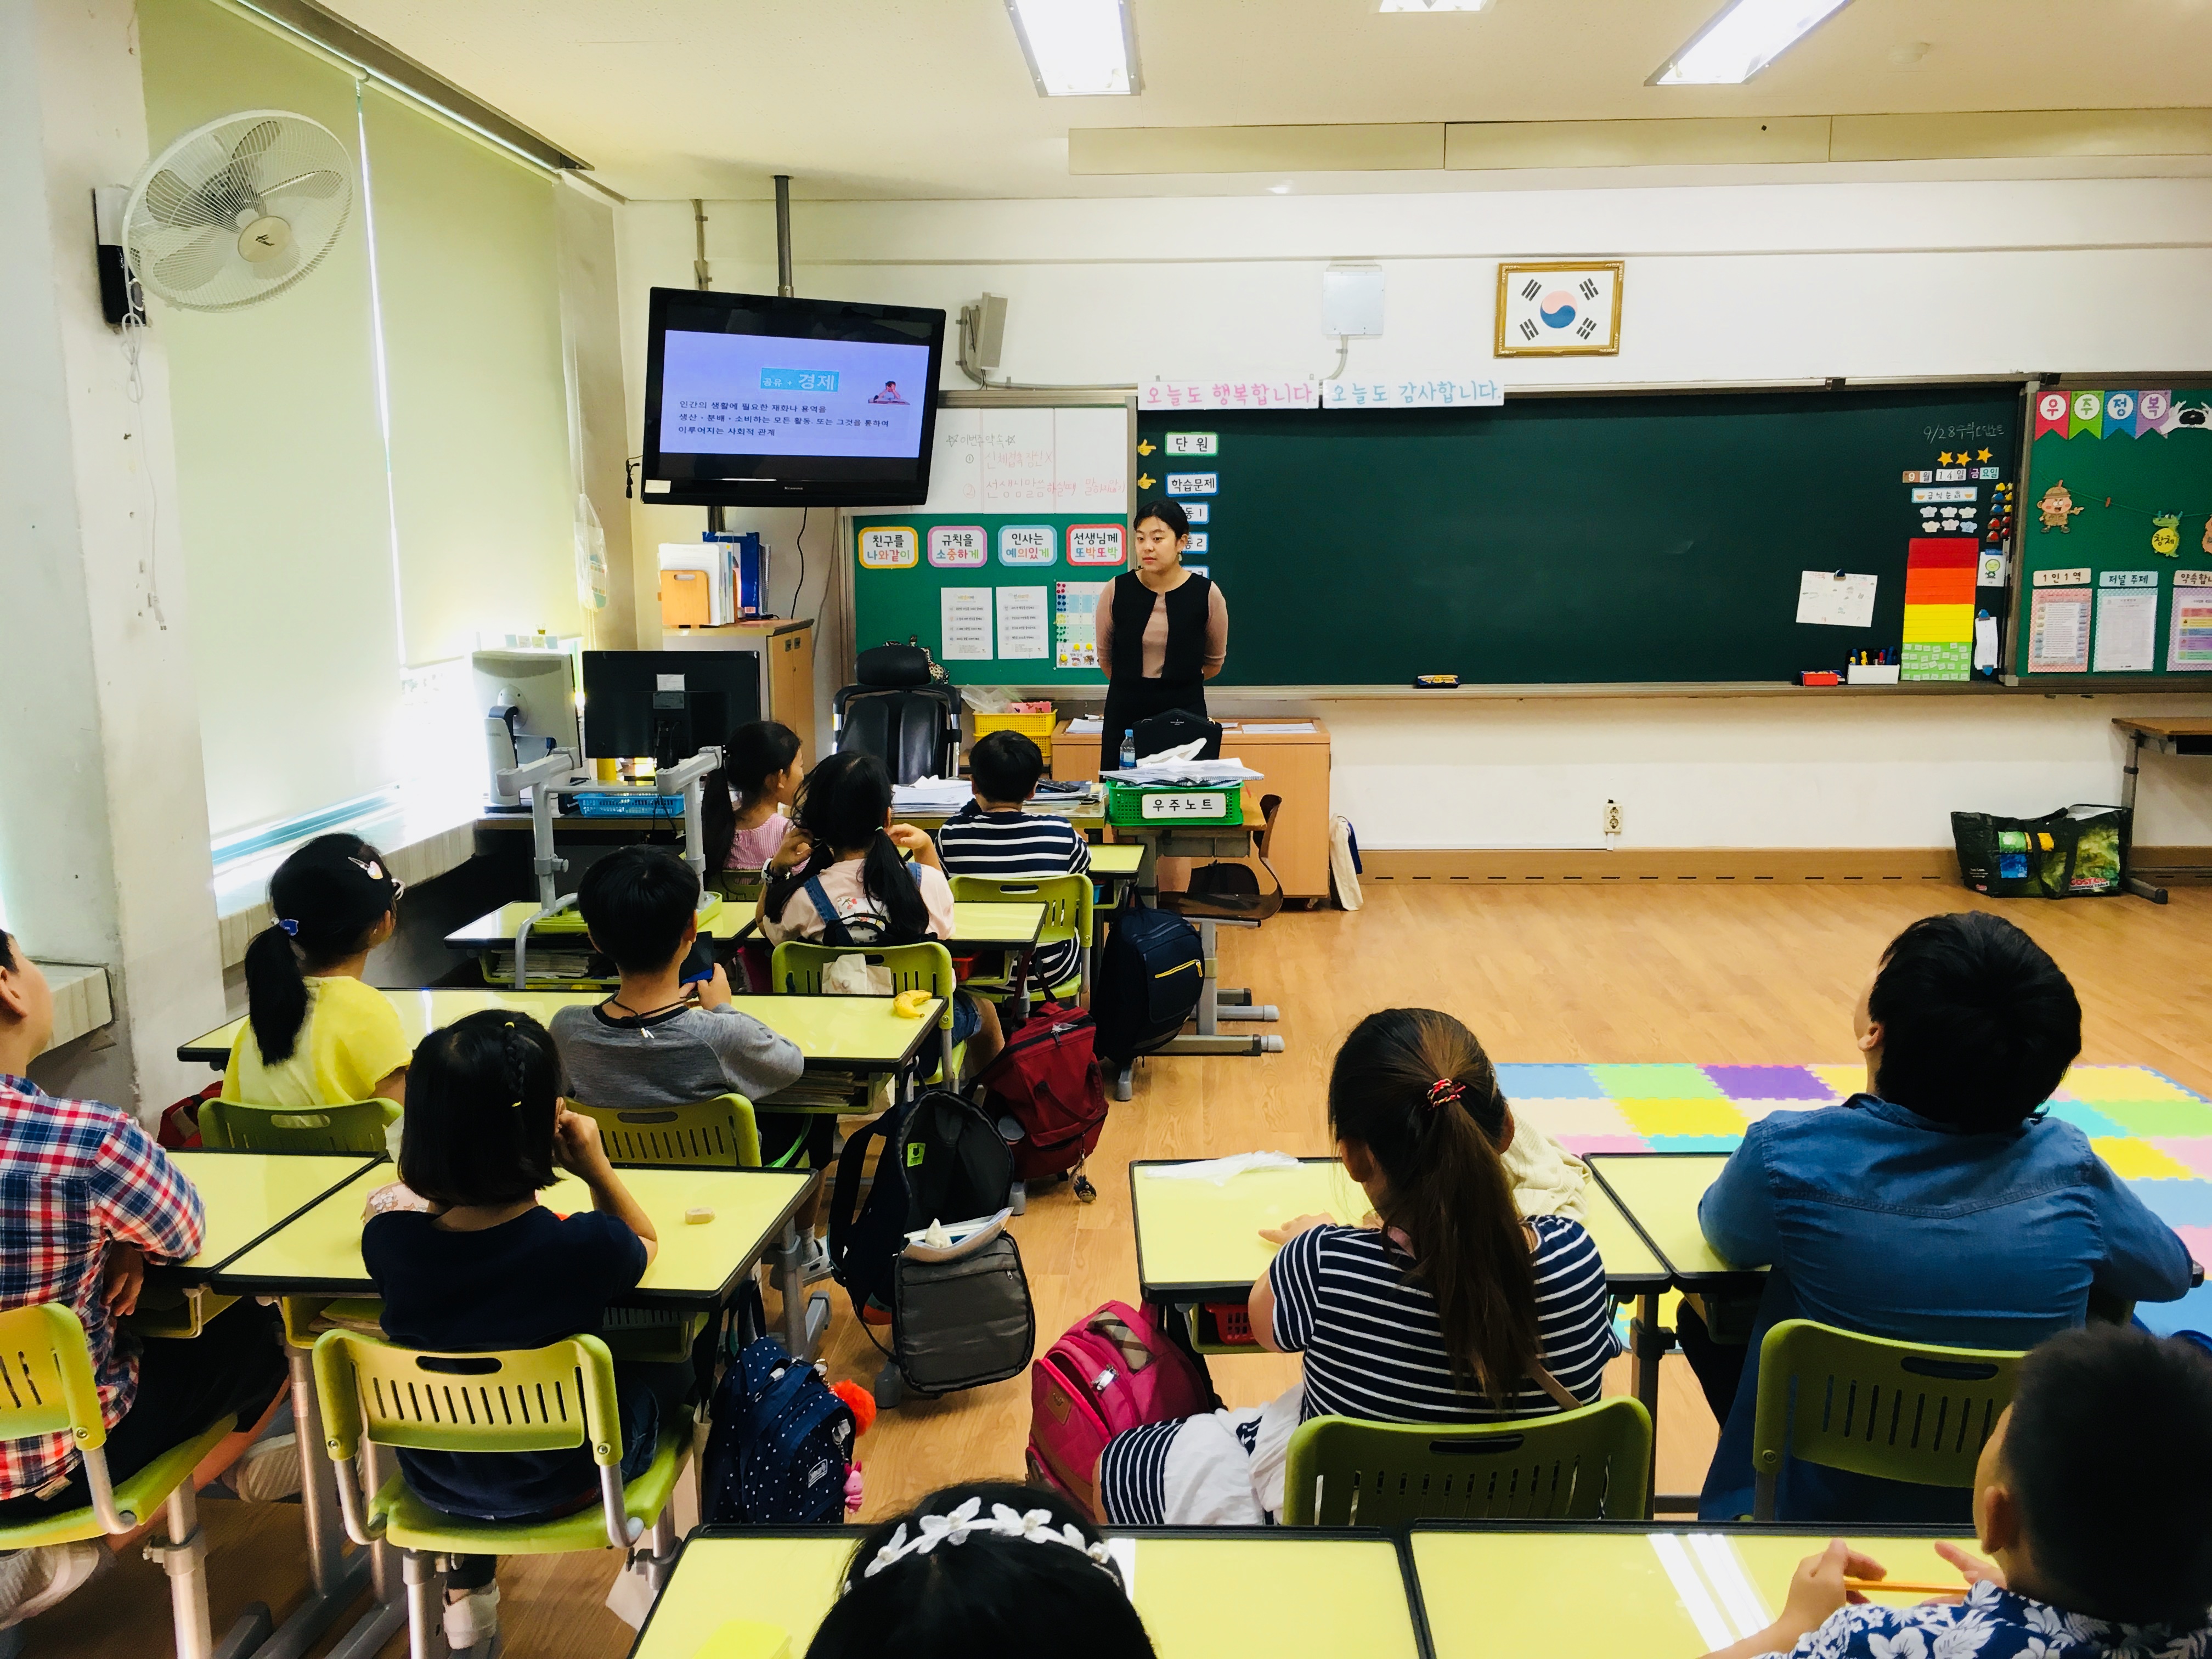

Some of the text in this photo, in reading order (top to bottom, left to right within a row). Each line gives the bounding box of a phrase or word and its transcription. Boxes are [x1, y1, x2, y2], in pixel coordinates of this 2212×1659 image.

[763, 377, 782, 387] 공유
[798, 374, 835, 391] 경제
[1147, 383, 1317, 407] 오늘도 행복합니다.
[1332, 380, 1502, 404] 오늘도 감사합니다.
[679, 400, 707, 409] 인간의
[711, 402, 738, 410] 생활에
[742, 403, 769, 411] 필요한
[801, 405, 827, 414] 용역을
[679, 413, 697, 421] 생산
[735, 415, 770, 424] 소비하는
[836, 419, 861, 427] 그것을
[865, 419, 889, 427] 통하여
[678, 426, 724, 435] 이루어지는
[727, 427, 754, 436] 사회적
[1171, 477, 1215, 492] 학습문제
[872, 534, 904, 548] 친구를
[941, 534, 973, 547] 규칙을
[1012, 533, 1043, 545] 인사는
[1074, 532, 1118, 545] 선생님께
[1197, 539, 1203, 547] 2
[867, 549, 910, 562] 나와같이
[936, 548, 979, 561] 소중하게
[1006, 547, 1049, 560] 예의있게
[1075, 546, 1118, 560] 또박또박
[2109, 574, 2149, 586] 저널 주제
[1153, 799, 1213, 812] 우주노트
